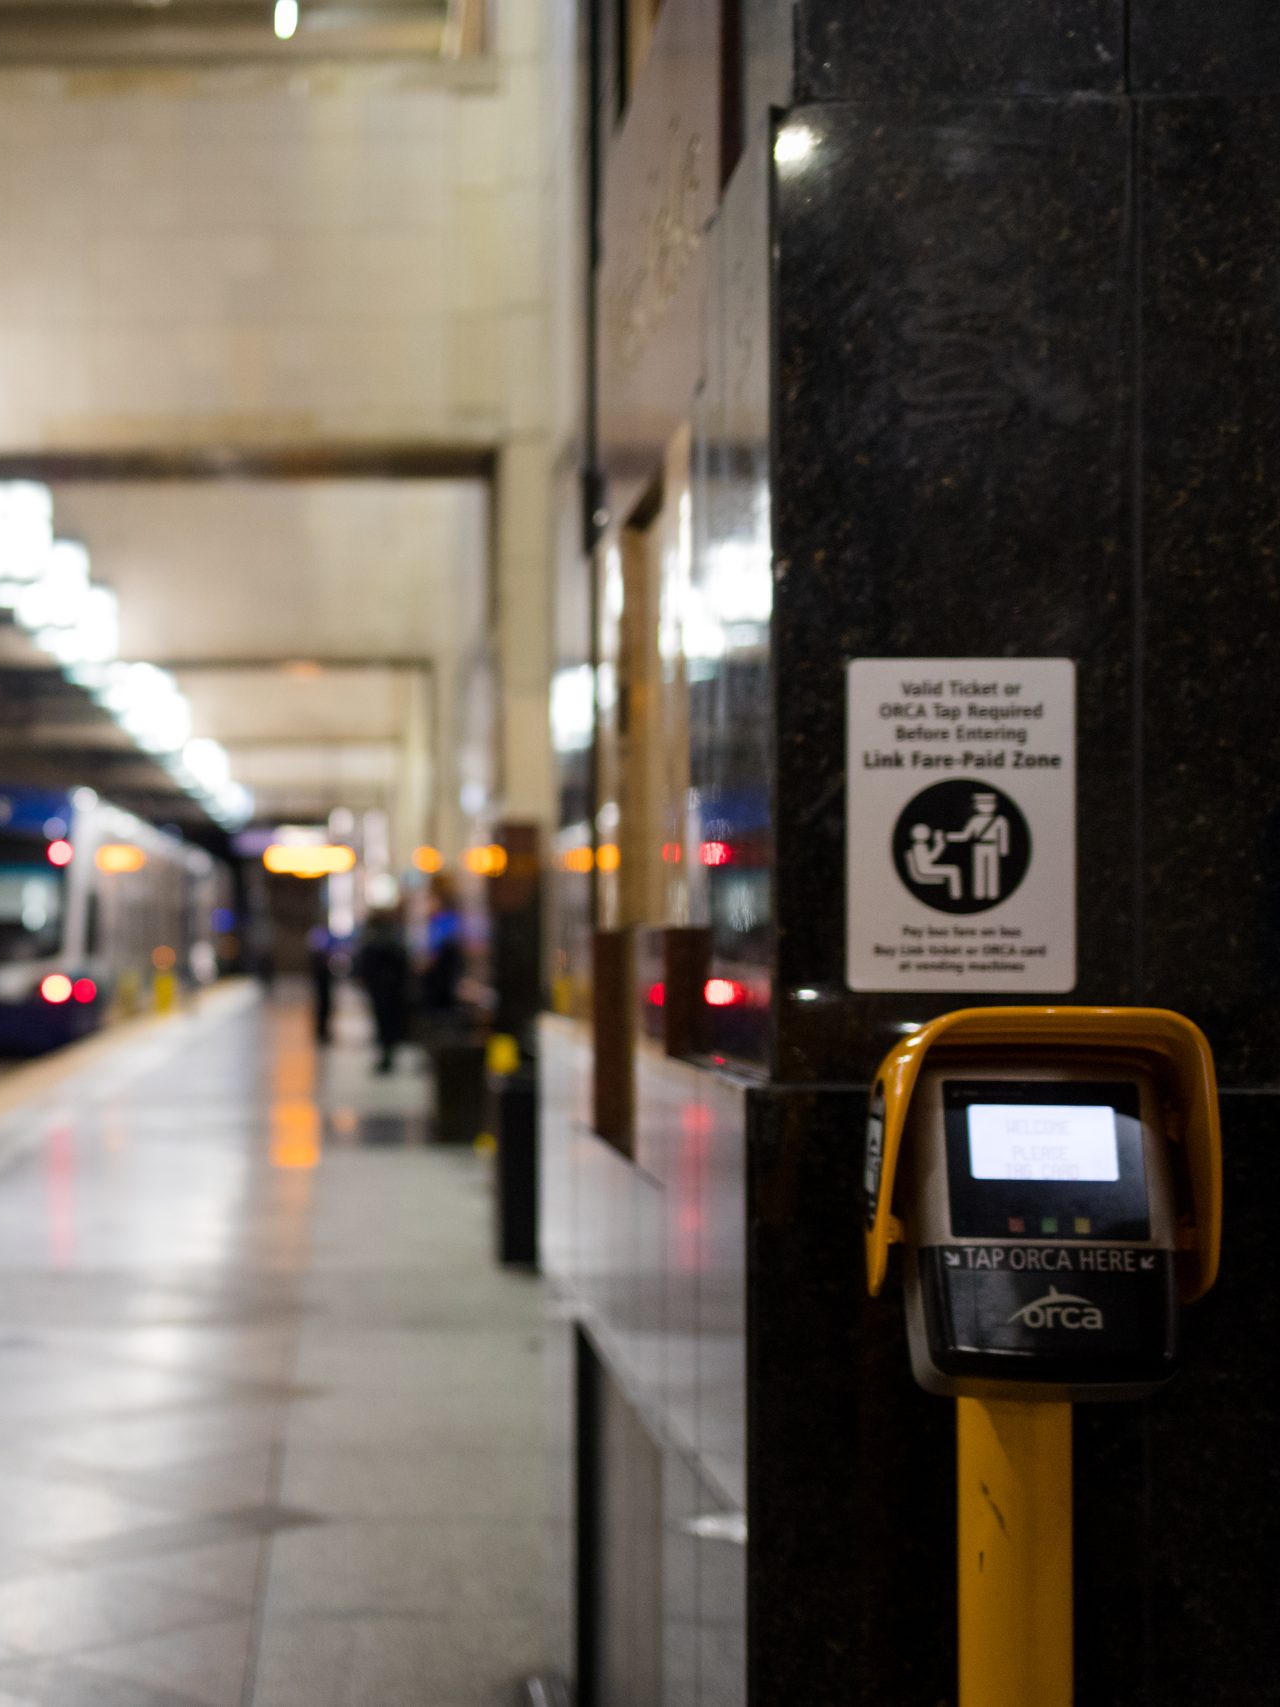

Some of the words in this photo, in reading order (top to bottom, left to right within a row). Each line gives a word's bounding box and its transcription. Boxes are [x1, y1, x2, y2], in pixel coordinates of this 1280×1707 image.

[901, 680, 942, 696] Valid
[950, 680, 997, 696] Ticket
[1004, 684, 1021, 696] or
[879, 703, 926, 718] ORCA
[934, 703, 961, 721] Tap
[968, 702, 1043, 720] Required
[896, 725, 949, 741] Before
[957, 725, 1027, 744] Entering
[863, 751, 904, 769] Link
[912, 751, 1005, 769] Fare-Paid
[1012, 752, 1062, 769] Zone
[983, 945, 1016, 955] ORCA
[1006, 1120, 1072, 1135] WELCOME
[1012, 1145, 1069, 1161] PLEASE
[965, 1248, 1004, 1268] TAP
[1009, 1248, 1072, 1271] ORCA
[1081, 1250, 1136, 1272] HERE
[1022, 1305, 1103, 1329] orca
